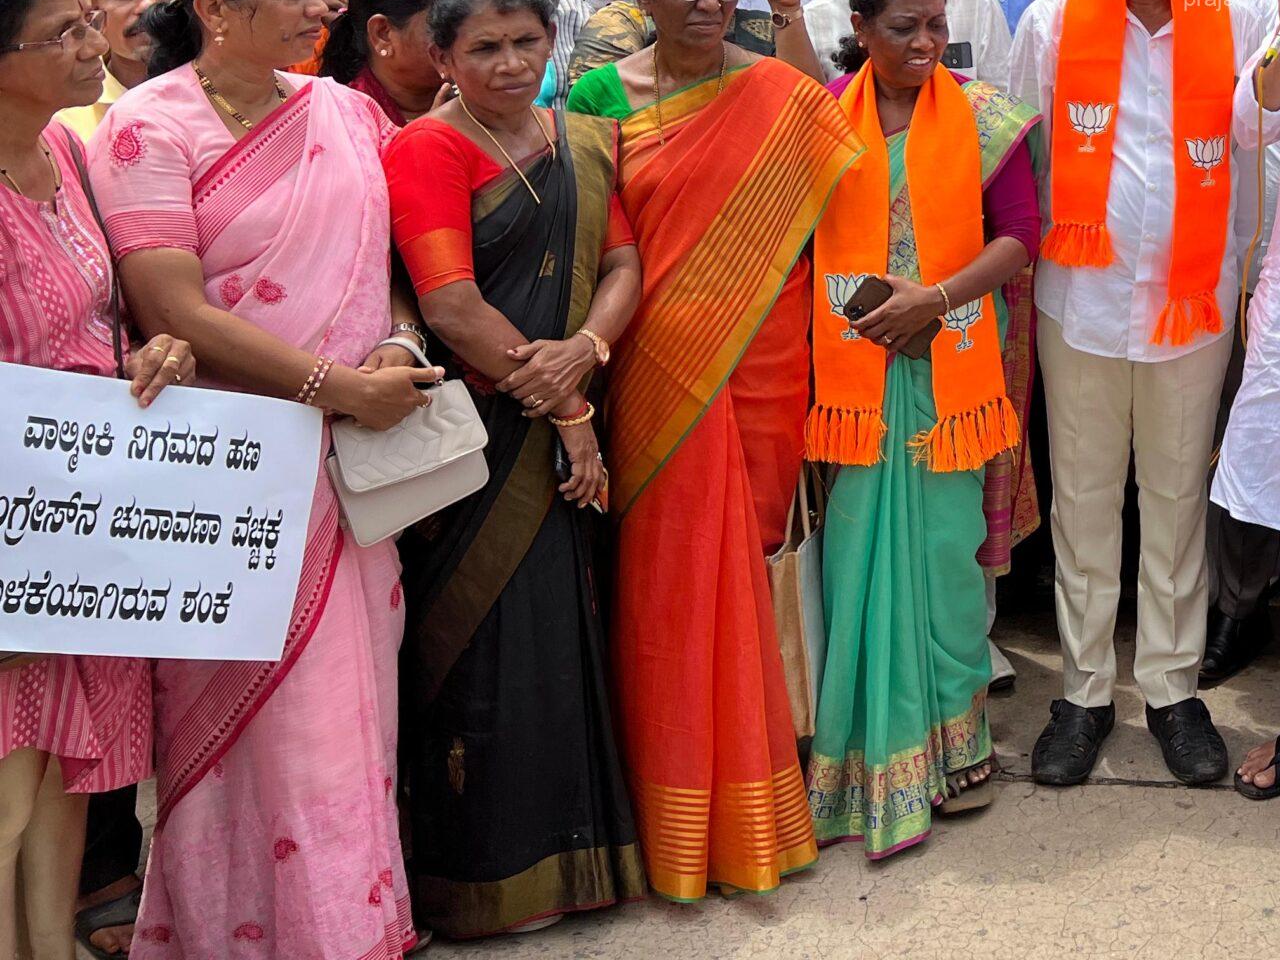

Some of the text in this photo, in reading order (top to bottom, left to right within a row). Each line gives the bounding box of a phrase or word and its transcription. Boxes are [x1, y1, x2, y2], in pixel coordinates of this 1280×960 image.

[24, 416, 261, 473] ವಾಲ್ಮೀಕಿ ನಿಗಮದ ಹಣ
[110, 495, 221, 545] ಚುನಾವಣಾ
[232, 506, 283, 570] ವೆಚ್ಚಕ್ಕೆ
[0, 570, 233, 624] ಳಕೆಯಾಗಿರುವ ಶಂಕೆ
